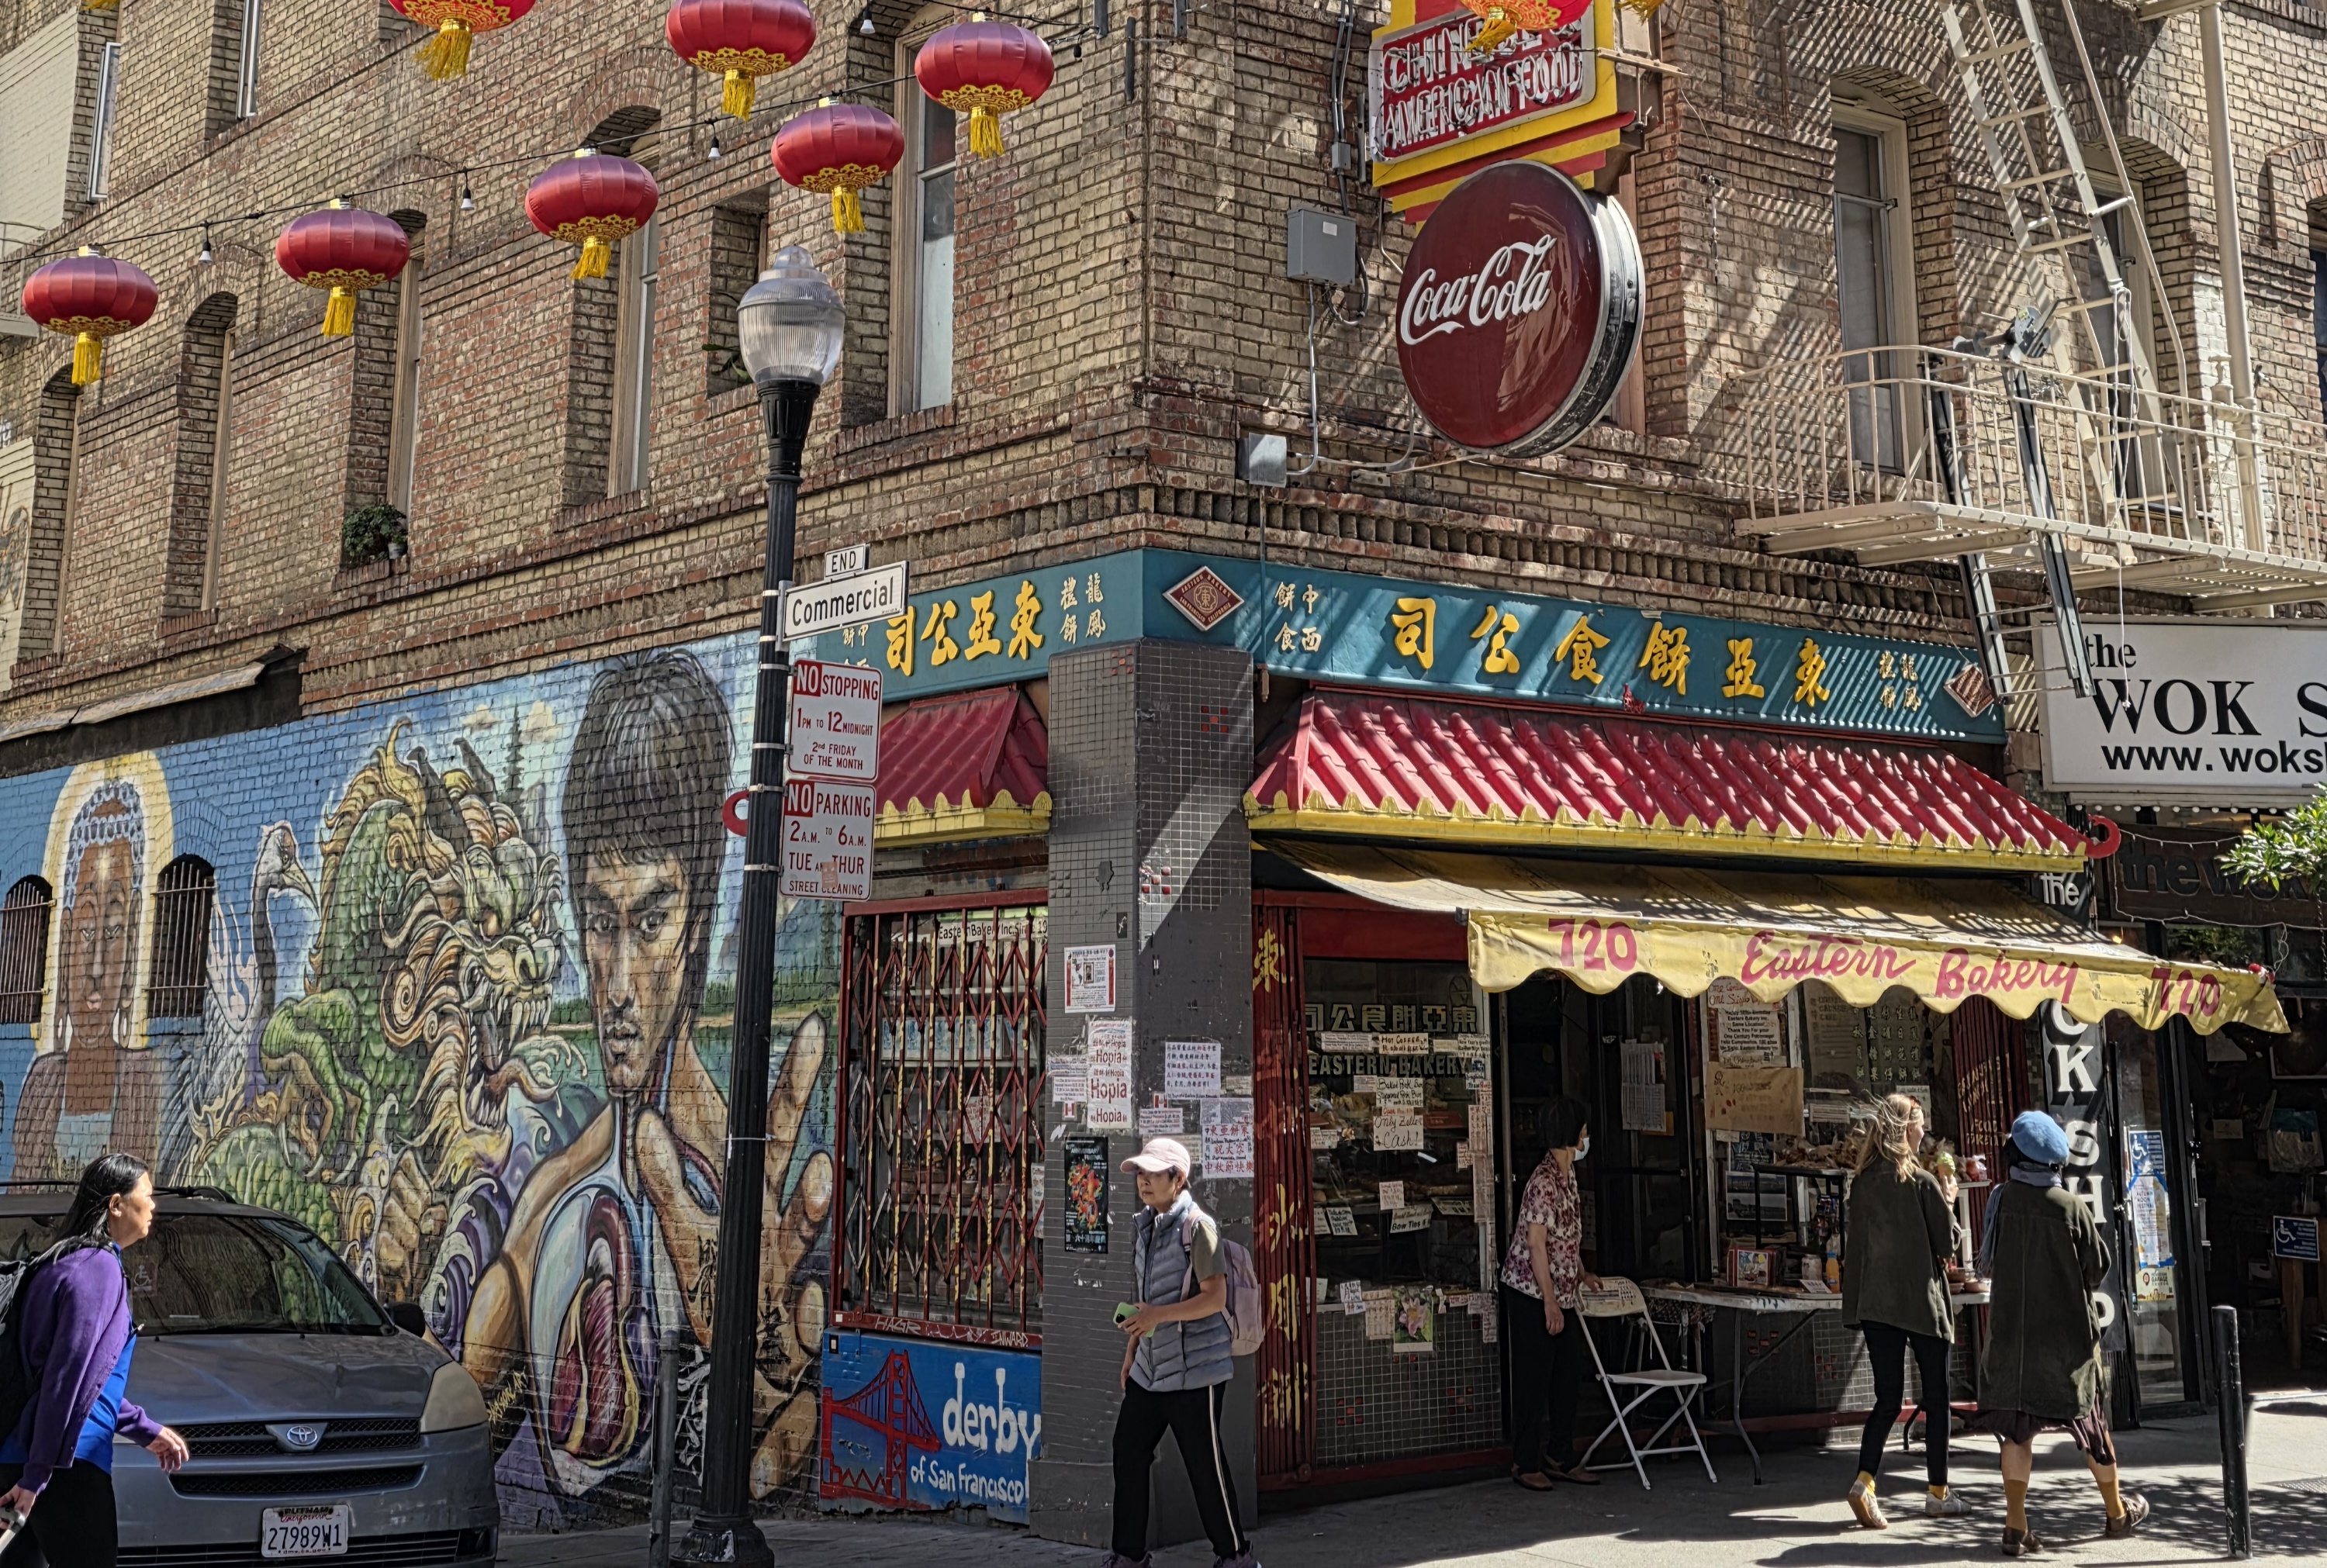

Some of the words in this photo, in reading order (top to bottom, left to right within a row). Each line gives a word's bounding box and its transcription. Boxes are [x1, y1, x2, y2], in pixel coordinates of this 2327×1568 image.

[1385, 70, 1511, 148] AMERICAN
[1505, 42, 1582, 110] FOOD
[1400, 234, 1558, 345] Coca-Cola
[832, 551, 856, 573] END
[1181, 574, 1203, 593] EASTERN
[1207, 575, 1231, 597] BAKERY
[793, 577, 894, 627] Commercial
[2086, 634, 2137, 668] the
[797, 664, 819, 694] NO
[822, 675, 879, 701] STOPPING
[2093, 678, 2262, 736] WOK
[816, 719, 824, 728] TO
[812, 742, 825, 753] 2nd
[828, 744, 857, 757] FRIDAY
[2101, 741, 2327, 773] www.woks
[804, 755, 814, 765] OF
[818, 756, 832, 767] THE
[836, 757, 863, 771] MONTH
[788, 784, 811, 813] NO
[815, 795, 871, 818] PARKING
[825, 827, 832, 836] TO
[789, 851, 813, 871] TUE
[789, 880, 819, 893] STREET
[2040, 872, 2080, 906] the
[1547, 917, 1637, 972] 720
[1741, 929, 1916, 986] Eastern
[1935, 947, 2080, 1004] Bakery
[2151, 966, 2220, 1017] 720
[1381, 1036, 1394, 1045] HOT
[1096, 1049, 1122, 1065] Hopia
[1309, 1055, 1390, 1075] EASTERN
[1398, 1055, 1468, 1075] BAKERY
[1091, 1078, 1127, 1103] Hopia
[1096, 1108, 1122, 1127] Hopia
[1374, 1117, 1396, 1133] Only
[1392, 1222, 1406, 1231] Bow
[1409, 1221, 1421, 1229] Ties
[2066, 1119, 2115, 1328] SHP
[943, 1363, 1042, 1498] derby
[911, 1456, 925, 1483] of
[930, 1460, 956, 1492] San
[958, 1463, 1024, 1504] Francisco
[280, 1514, 332, 1525] California
[268, 1524, 342, 1550] 27989W1
